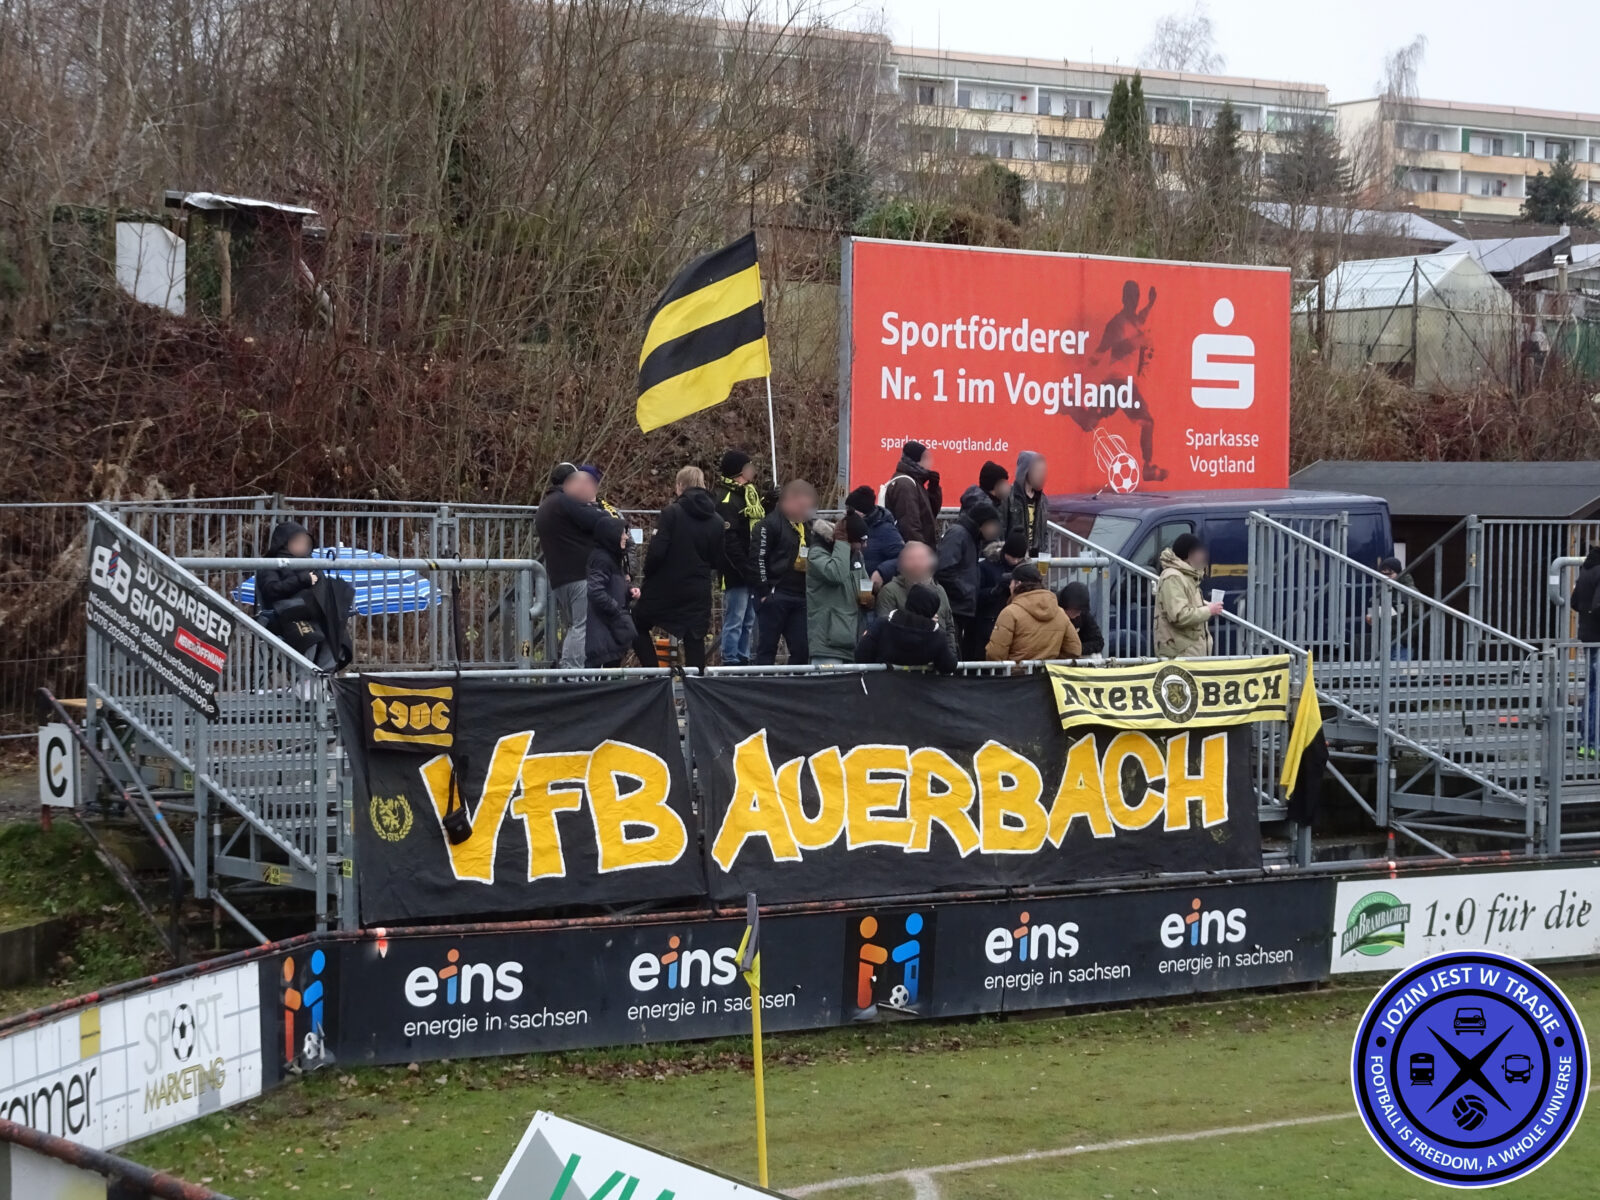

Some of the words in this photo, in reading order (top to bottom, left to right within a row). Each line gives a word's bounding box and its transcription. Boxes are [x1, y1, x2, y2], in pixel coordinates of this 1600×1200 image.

[881, 311, 1090, 355] Sportförderer
[881, 366, 921, 401] Nr.
[933, 369, 948, 402] 1
[958, 368, 995, 404] im
[1003, 372, 1141, 415] Vogtland.
[880, 434, 1009, 454] sparksse-vogtland.de
[1185, 428, 1259, 448] Sparkasse
[1190, 455, 1255, 477] Vogtland
[129, 588, 175, 637] SHOP
[135, 557, 232, 646] BOZBARBER
[46, 736, 68, 798] C
[710, 728, 1229, 873] AUERBACH
[984, 911, 1079, 964] eins
[1160, 898, 1247, 949] eins
[1423, 897, 1475, 939] 1:0
[1484, 893, 1536, 945] für
[1544, 889, 1592, 930] die
[404, 948, 524, 1007] eins
[629, 935, 737, 992] eins
[984, 971, 1044, 991] energie
[1049, 969, 1063, 985] in
[1068, 962, 1131, 983] sachsen
[1158, 955, 1213, 975] energie
[1217, 951, 1231, 968] in
[1235, 944, 1294, 966] sachsen
[403, 1016, 478, 1039] energie
[485, 1015, 503, 1032] in
[509, 1007, 588, 1029] sachsen
[627, 998, 695, 1022] energie
[702, 996, 717, 1014] in
[143, 1056, 226, 1114] MARKETING
